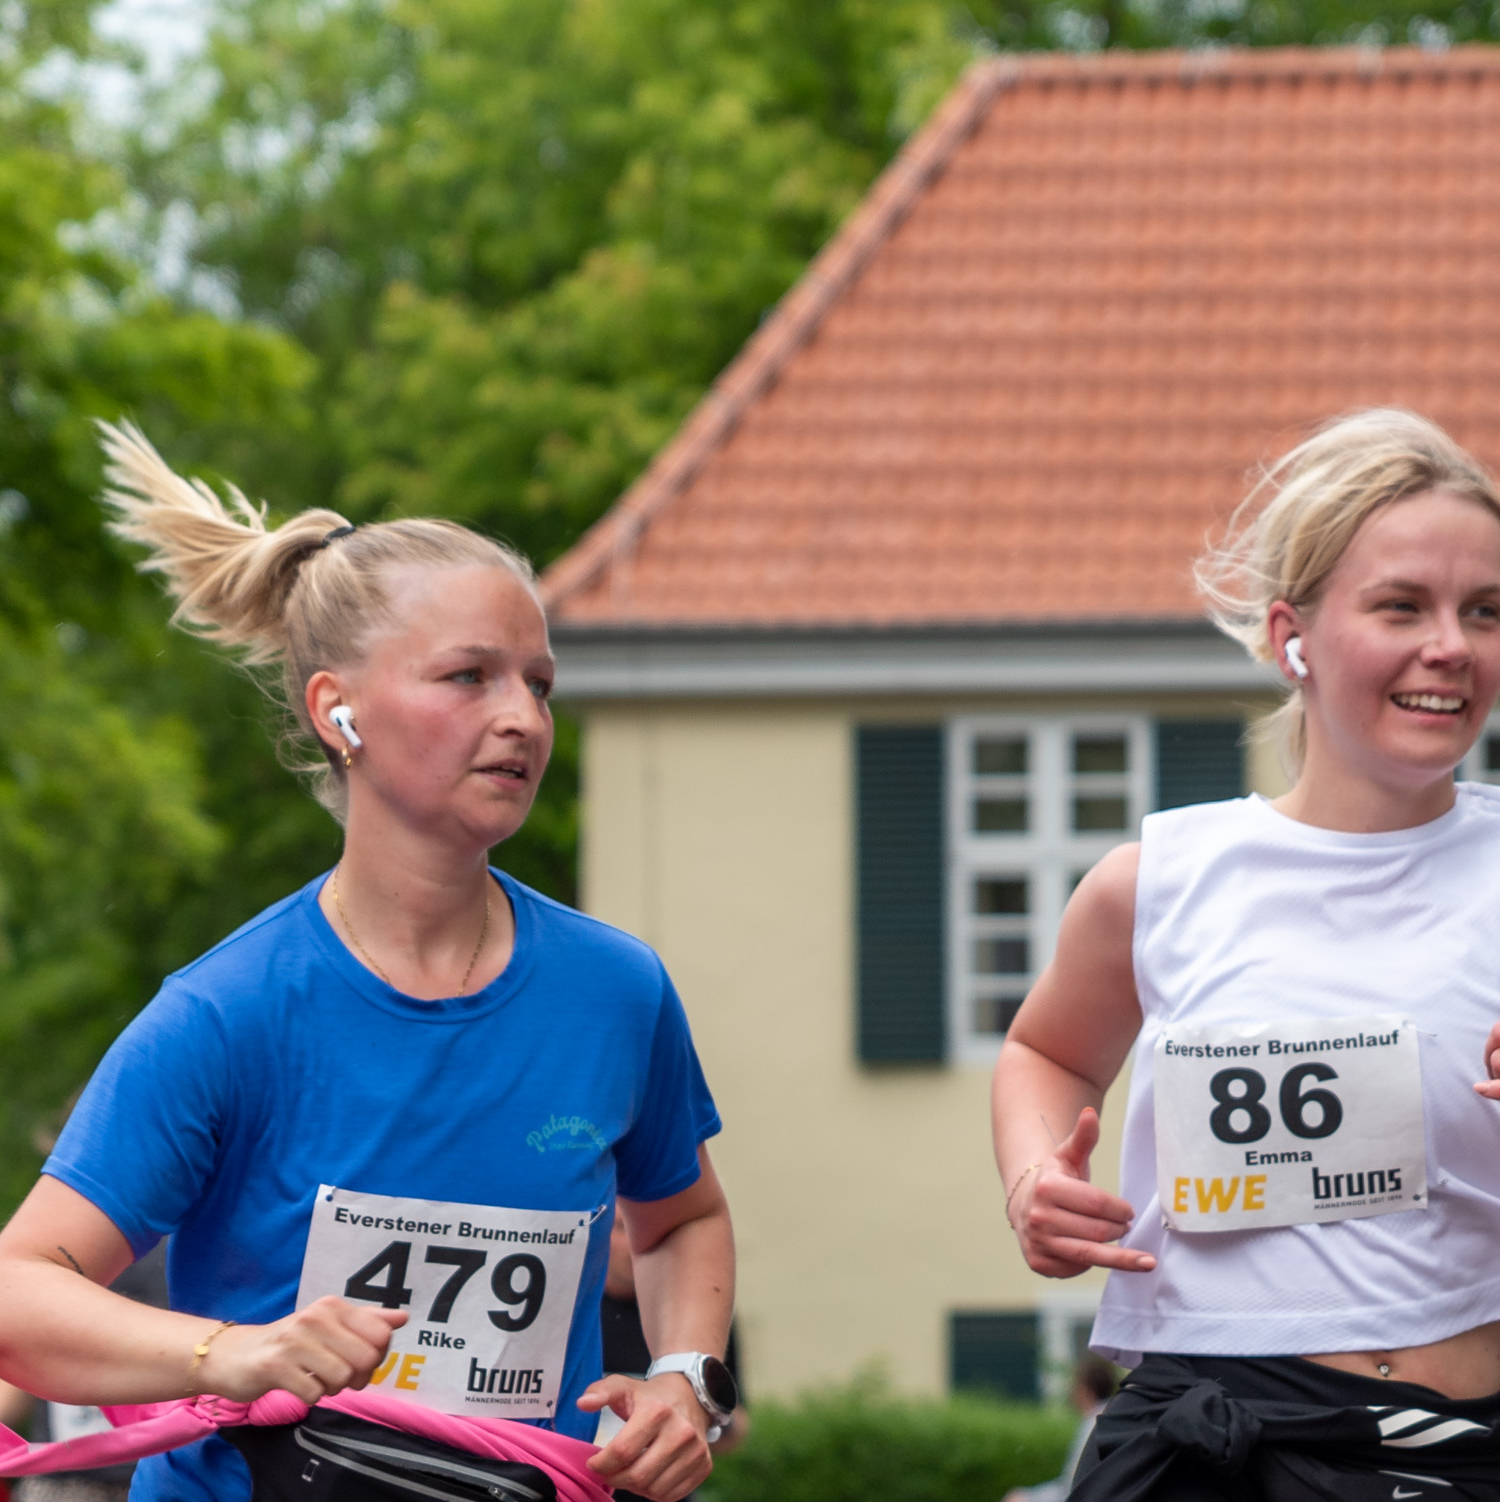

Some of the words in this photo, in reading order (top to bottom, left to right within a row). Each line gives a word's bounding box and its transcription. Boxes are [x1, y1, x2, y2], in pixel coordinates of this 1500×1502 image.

[1164, 1039, 1260, 1058] Everstener
[1267, 1029, 1400, 1056] Brunnenlauf
[1209, 1061, 1343, 1145] 86
[526, 1113, 608, 1153] Patagonia
[1244, 1150, 1313, 1166] Emma
[1173, 1174, 1267, 1214] EWE
[1312, 1166, 1402, 1200] bruns
[1369, 1196, 1385, 1204] SEIT
[333, 1207, 452, 1236] Everstener
[457, 1221, 577, 1246] Brunnenlauf
[343, 1240, 547, 1333] 479
[417, 1330, 466, 1350] Rike
[467, 1357, 544, 1394] bruns
